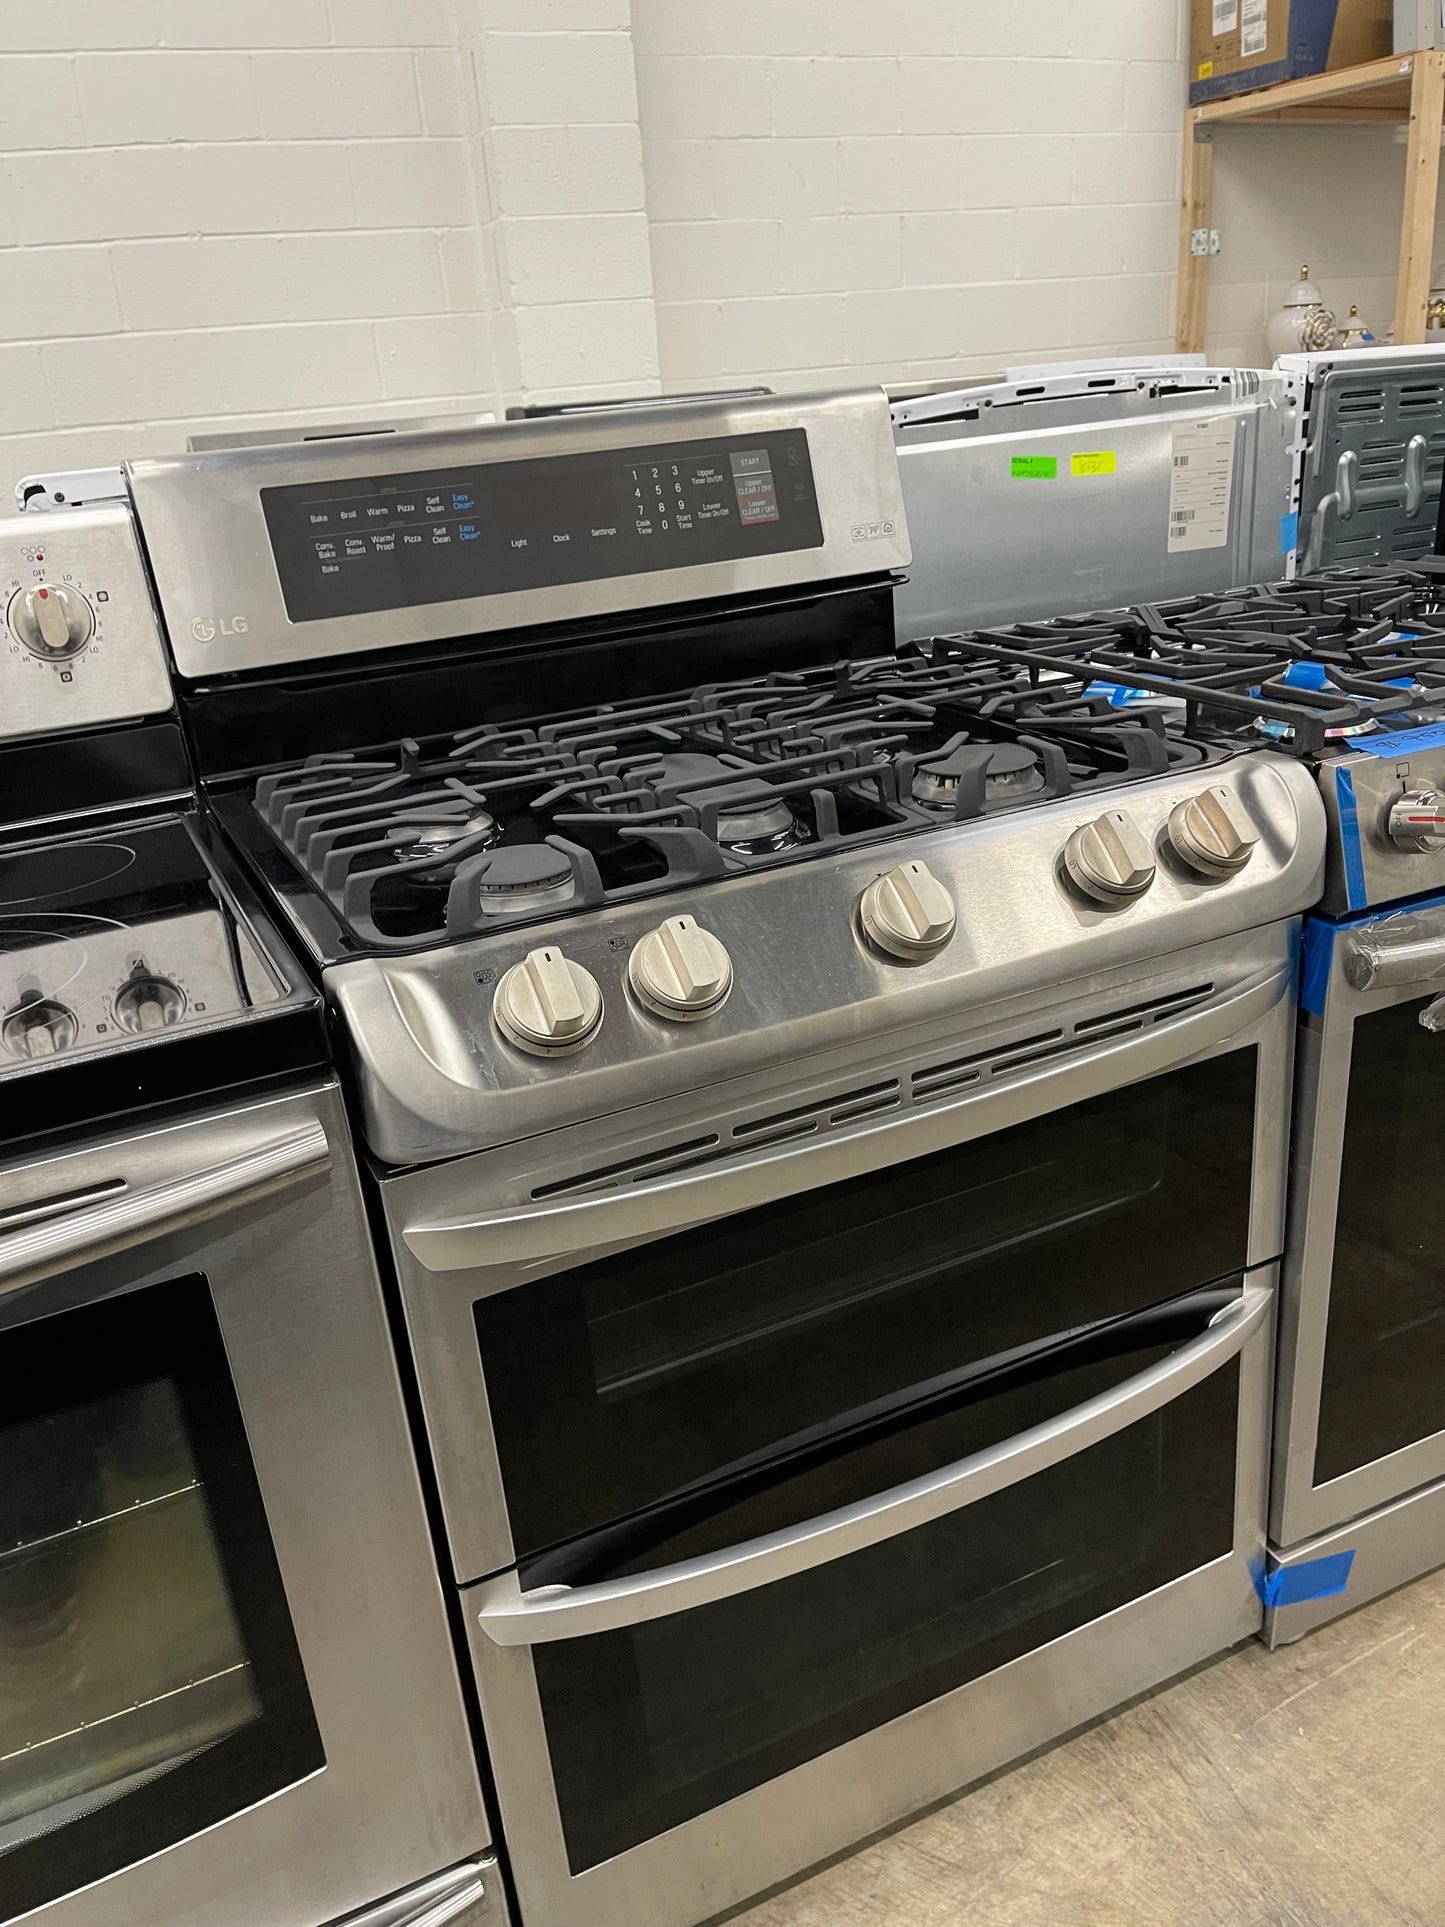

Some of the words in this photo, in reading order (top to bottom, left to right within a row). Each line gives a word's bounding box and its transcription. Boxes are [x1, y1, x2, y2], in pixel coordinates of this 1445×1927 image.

[740, 458, 760, 467] START
[632, 470, 637, 480] 1
[652, 468, 659, 478] 2
[671, 465, 679, 476] 3
[697, 469, 714, 477] Upper
[634, 487, 641, 498] 4
[655, 485, 662, 496] 5
[675, 483, 682, 493] 6
[738, 487, 757, 495] CLEAR
[426, 496, 440, 505] Self
[452, 493, 468, 502] Easy
[397, 504, 415, 512] Pizza
[425, 505, 445, 514] Clean
[658, 502, 665, 512] 8
[678, 500, 685, 510] 9
[702, 503, 721, 511] Lower
[340, 510, 357, 519] Broil
[366, 508, 389, 516] Warm
[637, 505, 643, 515] 7
[742, 508, 760, 516] CLEAR
[765, 505, 775, 513] OFF
[310, 515, 328, 523] Bake
[676, 514, 692, 522] Start
[459, 524, 474, 532] Easy
[661, 519, 668, 530] 0
[433, 527, 447, 536] Self
[591, 528, 617, 536] Settings
[345, 538, 365, 547] Conv.
[371, 533, 395, 543] Warm/
[403, 535, 422, 543] Pizza
[432, 536, 451, 544] Clean
[552, 534, 570, 542] Clock
[315, 542, 336, 550] Conv.
[376, 542, 395, 551] Proof
[511, 539, 528, 548] Light
[318, 550, 336, 559] Bake
[346, 547, 367, 555] Roast
[32, 569, 46, 577] OFF
[321, 565, 339, 573] Bake
[62, 574, 73, 582] LO
[219, 616, 249, 635] LG
